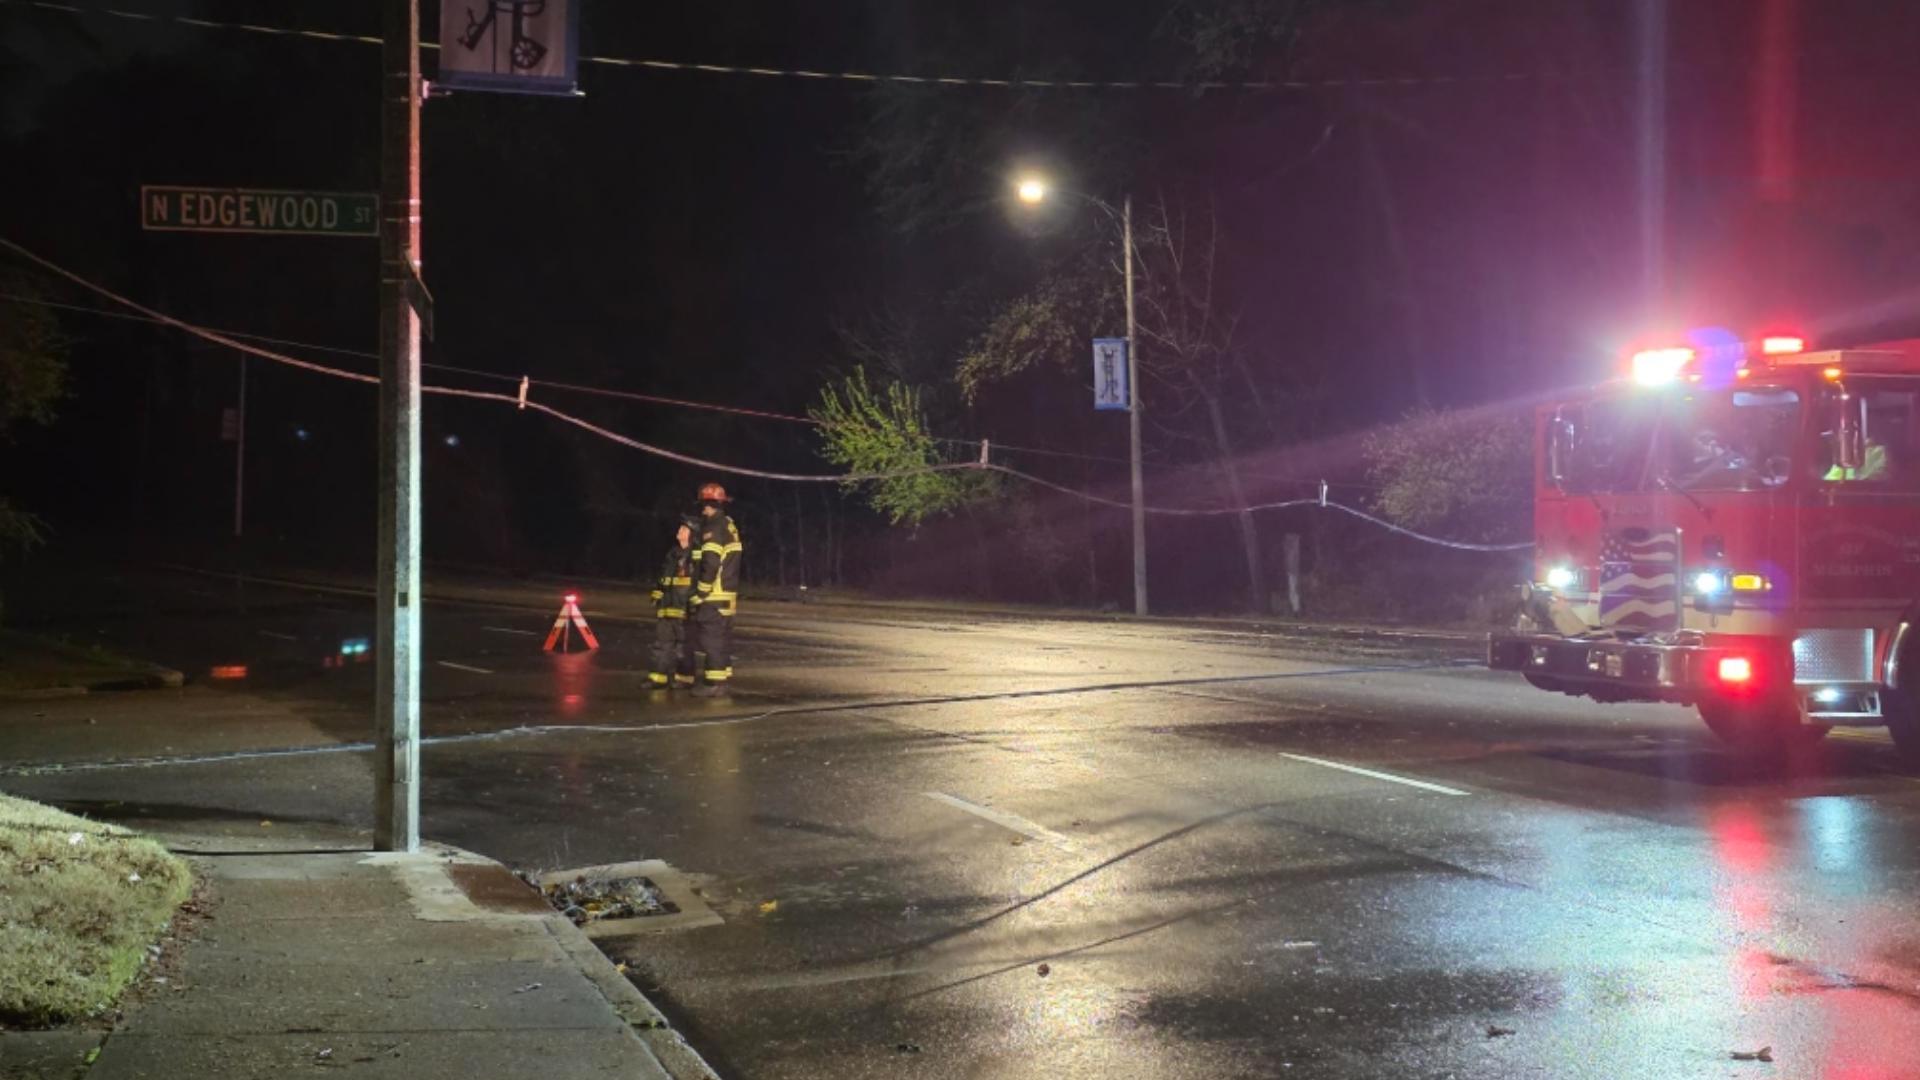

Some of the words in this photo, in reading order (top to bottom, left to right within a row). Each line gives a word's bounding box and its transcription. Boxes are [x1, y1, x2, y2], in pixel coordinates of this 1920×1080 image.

[151, 194, 169, 221] N
[180, 193, 339, 229] EDGEWOOD
[353, 206, 371, 224] ST
